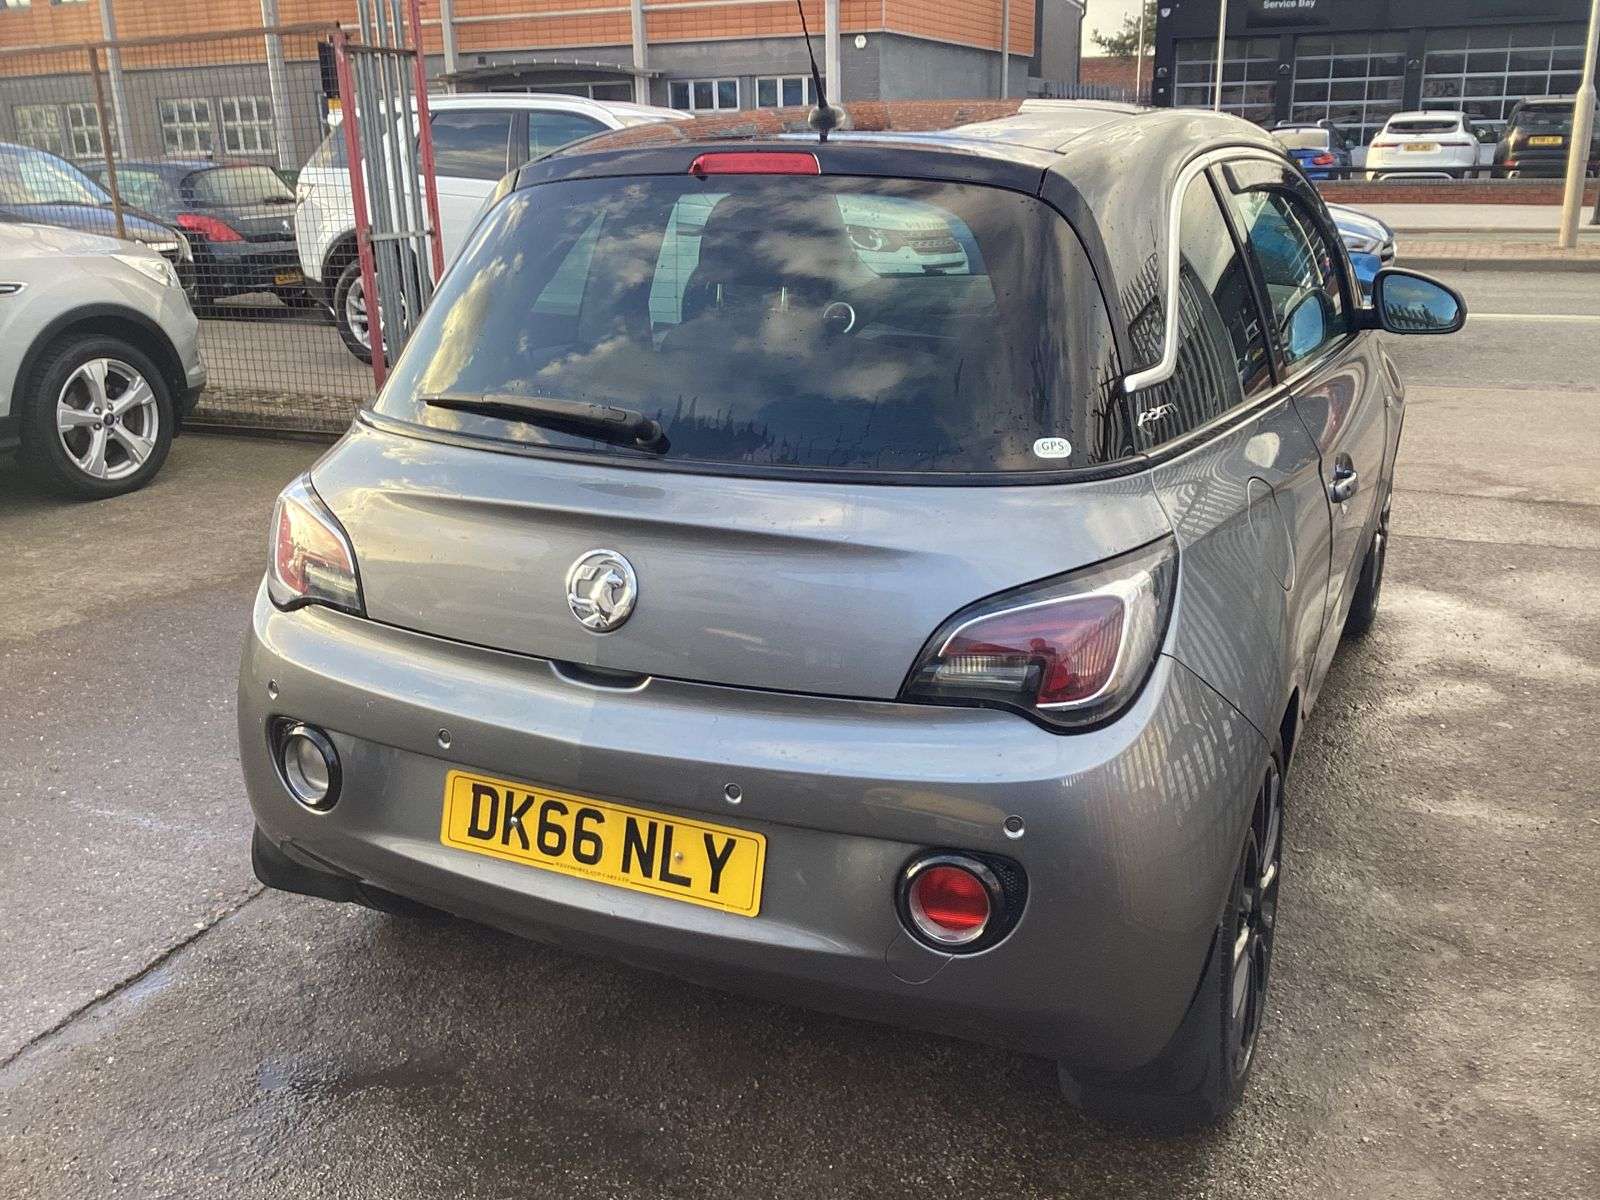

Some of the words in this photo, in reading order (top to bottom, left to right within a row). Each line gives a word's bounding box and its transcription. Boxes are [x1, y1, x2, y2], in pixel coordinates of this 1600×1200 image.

[1264, 0, 1297, 9] Service
[1298, 0, 1317, 9] Bay
[1041, 441, 1064, 451] GPS
[468, 783, 605, 866] DK66
[621, 816, 737, 895] NLY
